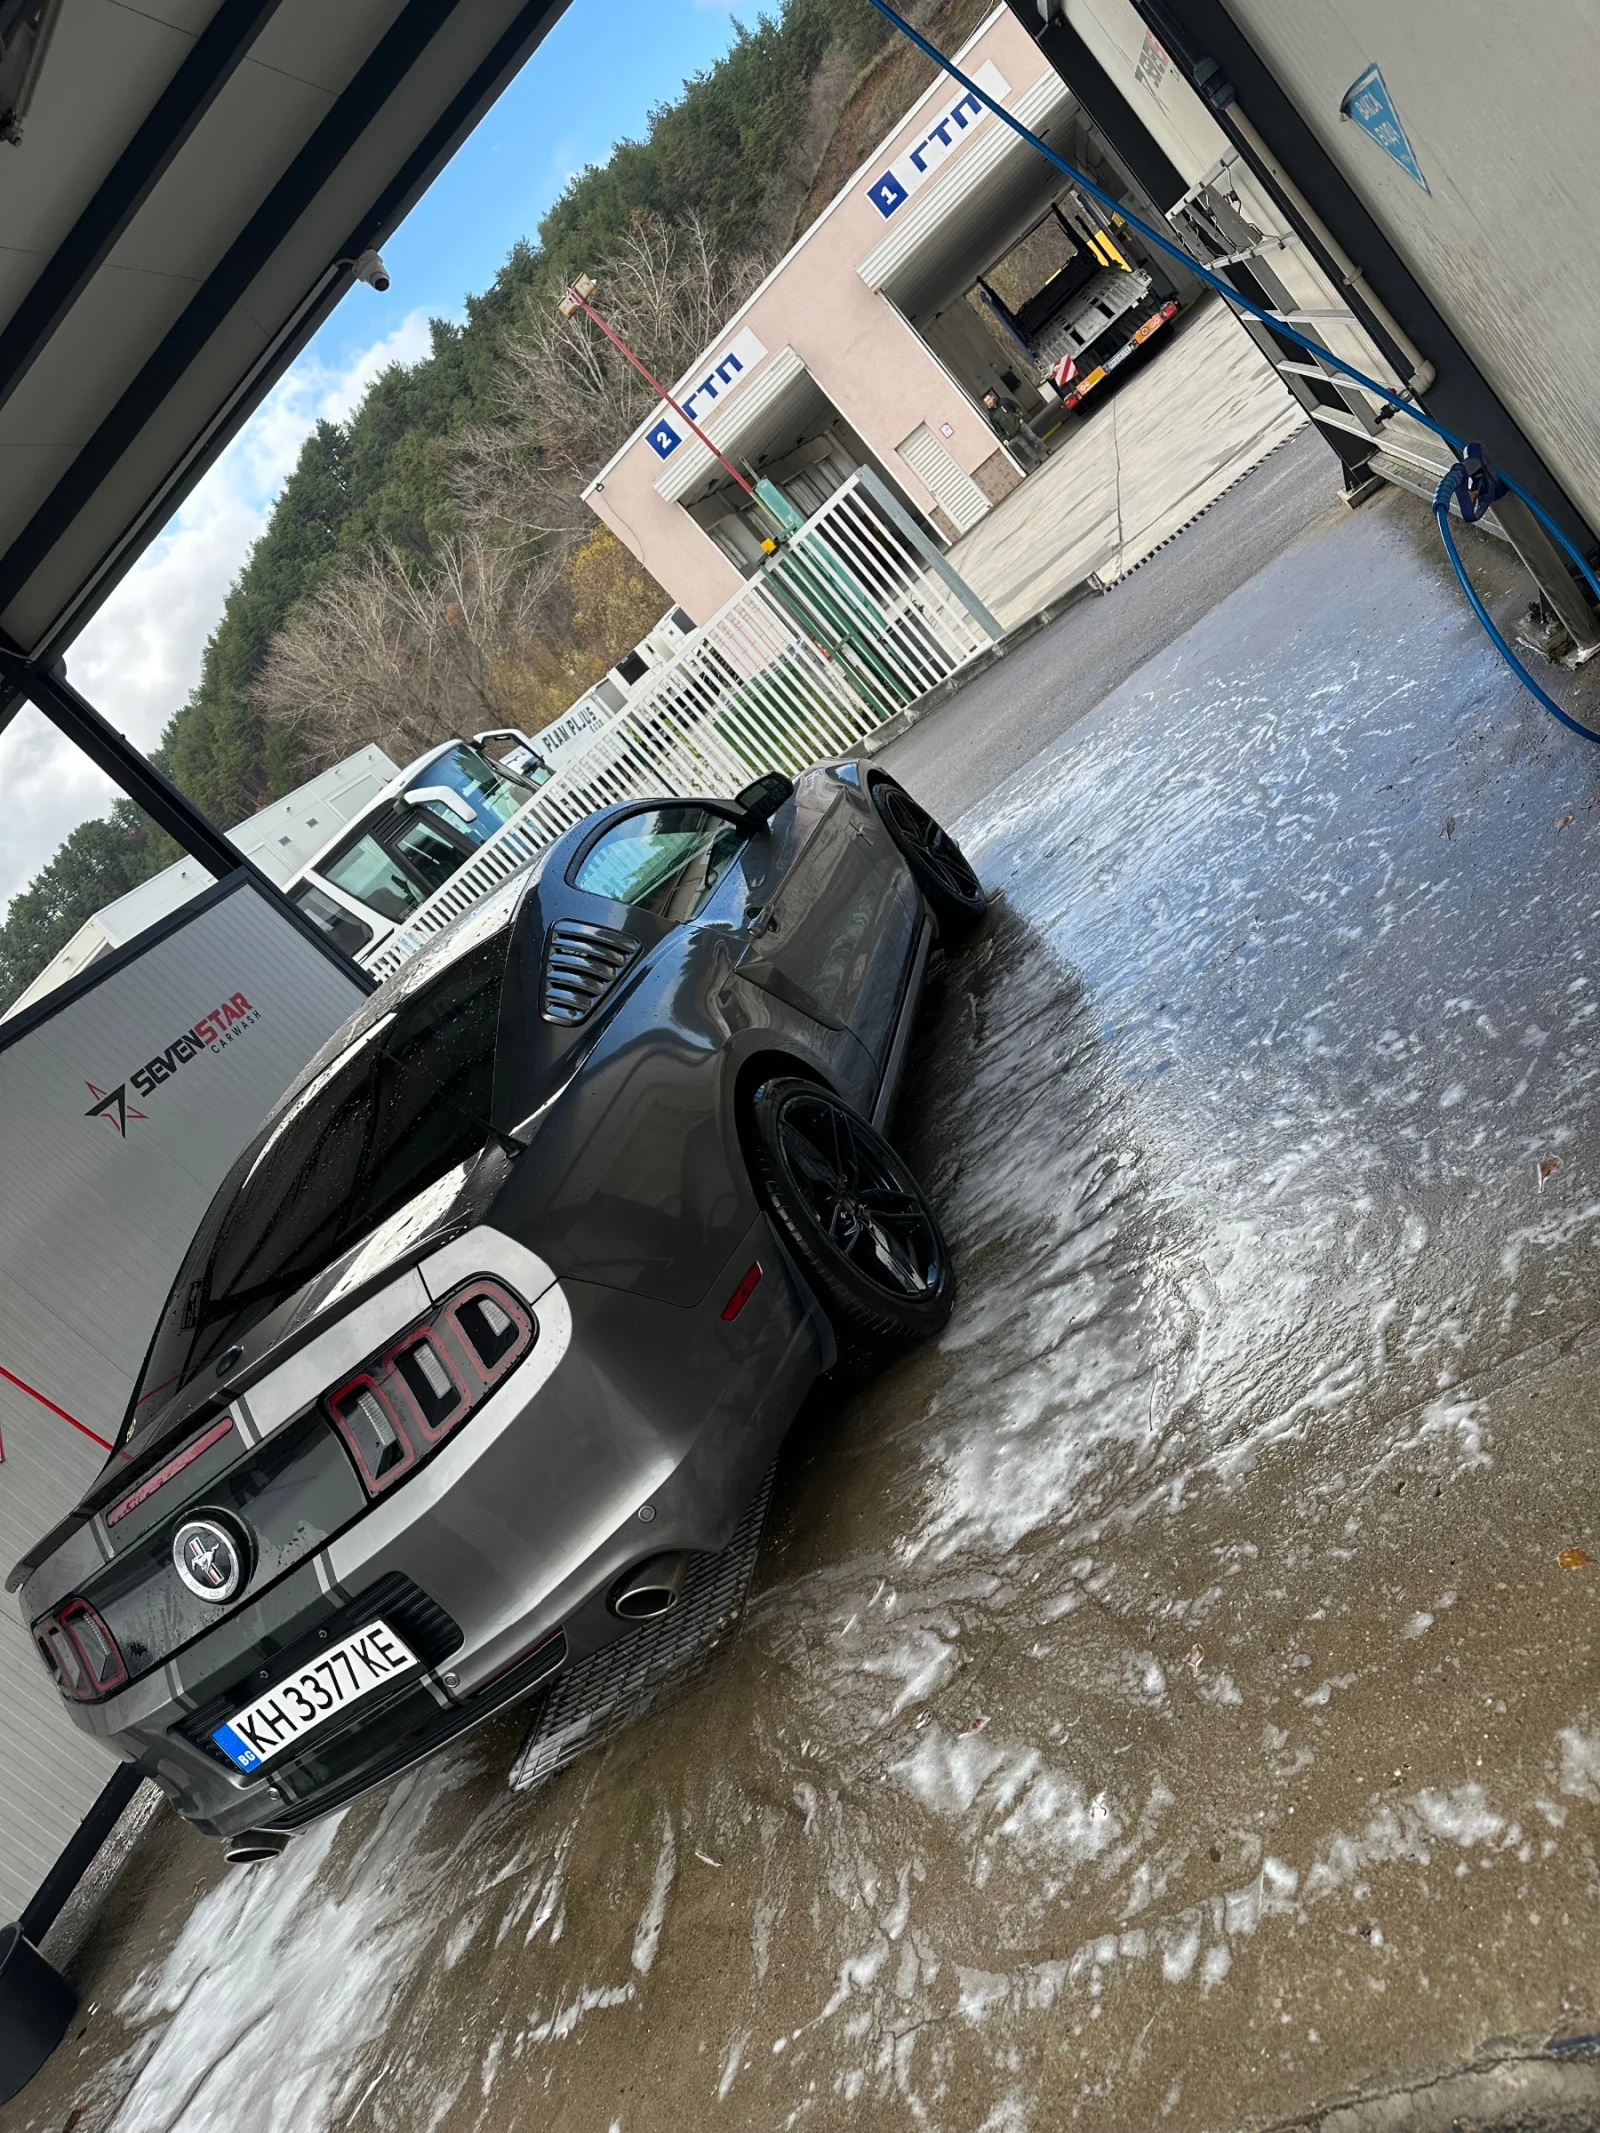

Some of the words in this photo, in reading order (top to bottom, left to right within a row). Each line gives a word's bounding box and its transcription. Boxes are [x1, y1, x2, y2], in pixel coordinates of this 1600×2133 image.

[880, 185, 898, 206] 1
[909, 92, 983, 173] ГТП
[1374, 120, 1401, 147] ВОДА
[656, 431, 673, 450] 2
[681, 352, 744, 421] ГТП
[566, 706, 597, 736] PLJUS
[210, 1010, 262, 1054] CARWASH
[237, 1750, 256, 1767] BG
